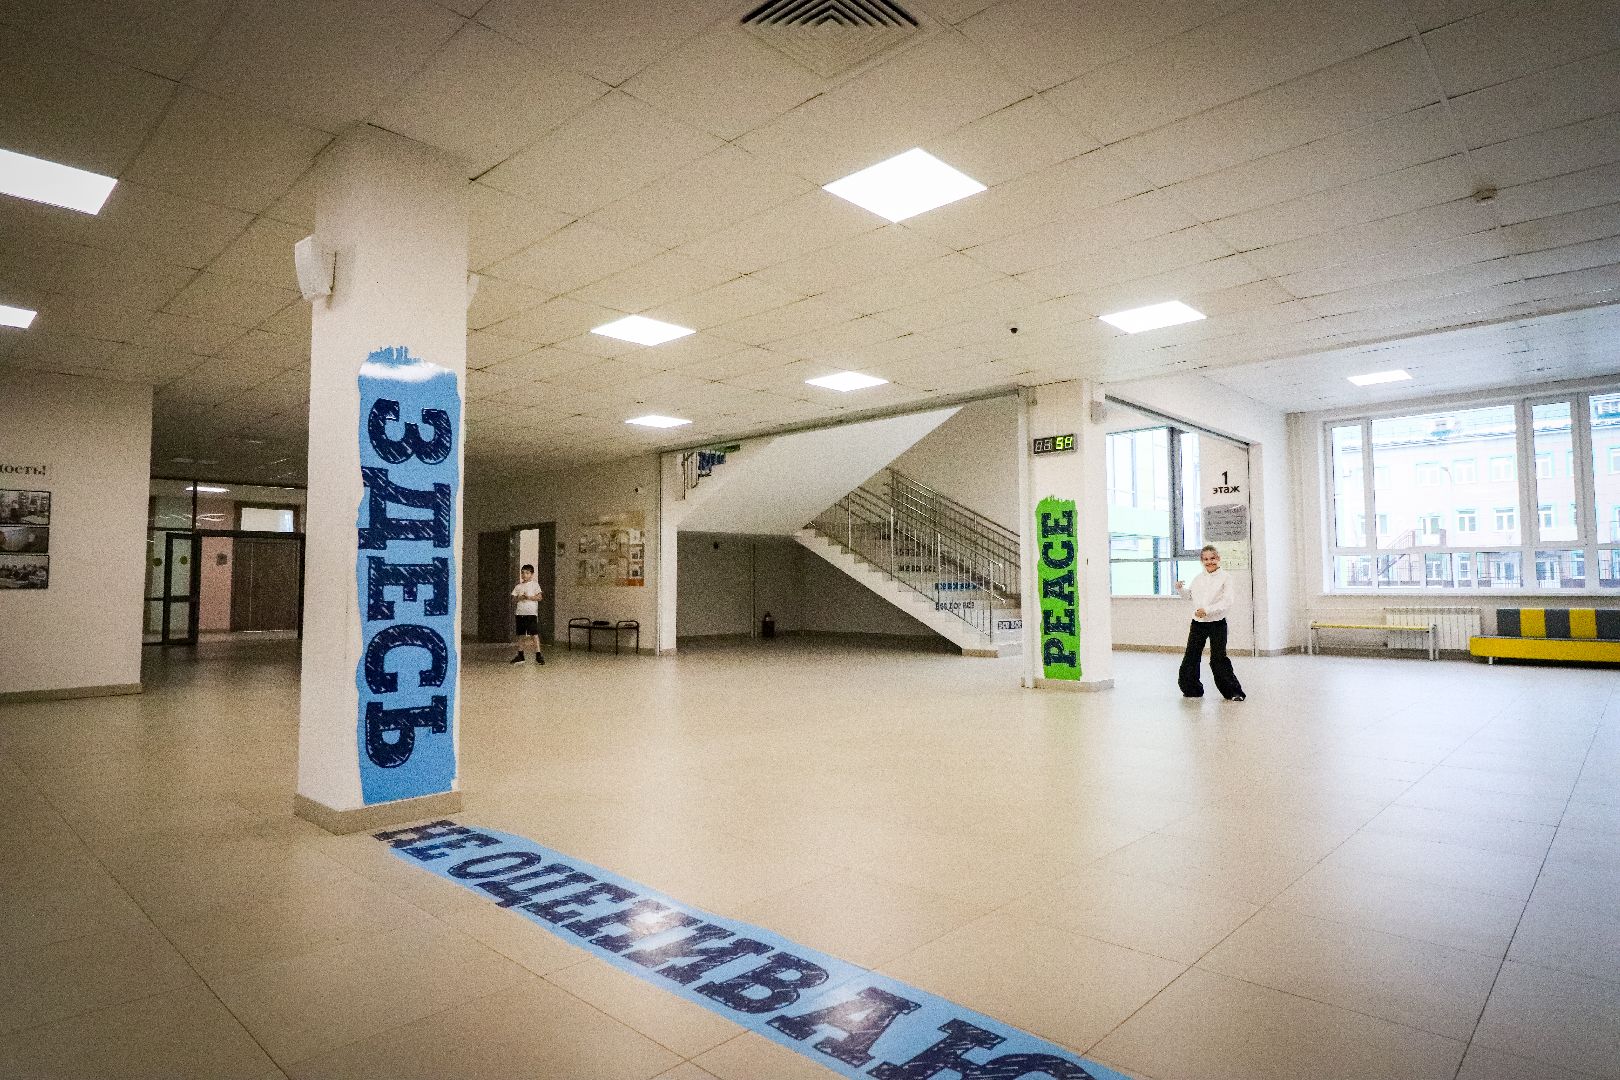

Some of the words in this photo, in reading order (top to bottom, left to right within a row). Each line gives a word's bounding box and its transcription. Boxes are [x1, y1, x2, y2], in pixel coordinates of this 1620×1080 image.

[1213, 485, 1240, 494] этаж
[1222, 471, 1228, 485] 1
[358, 398, 453, 769] ЗДЕСЬ
[1041, 510, 1076, 667] PEACE
[372, 819, 502, 862] НЕ
